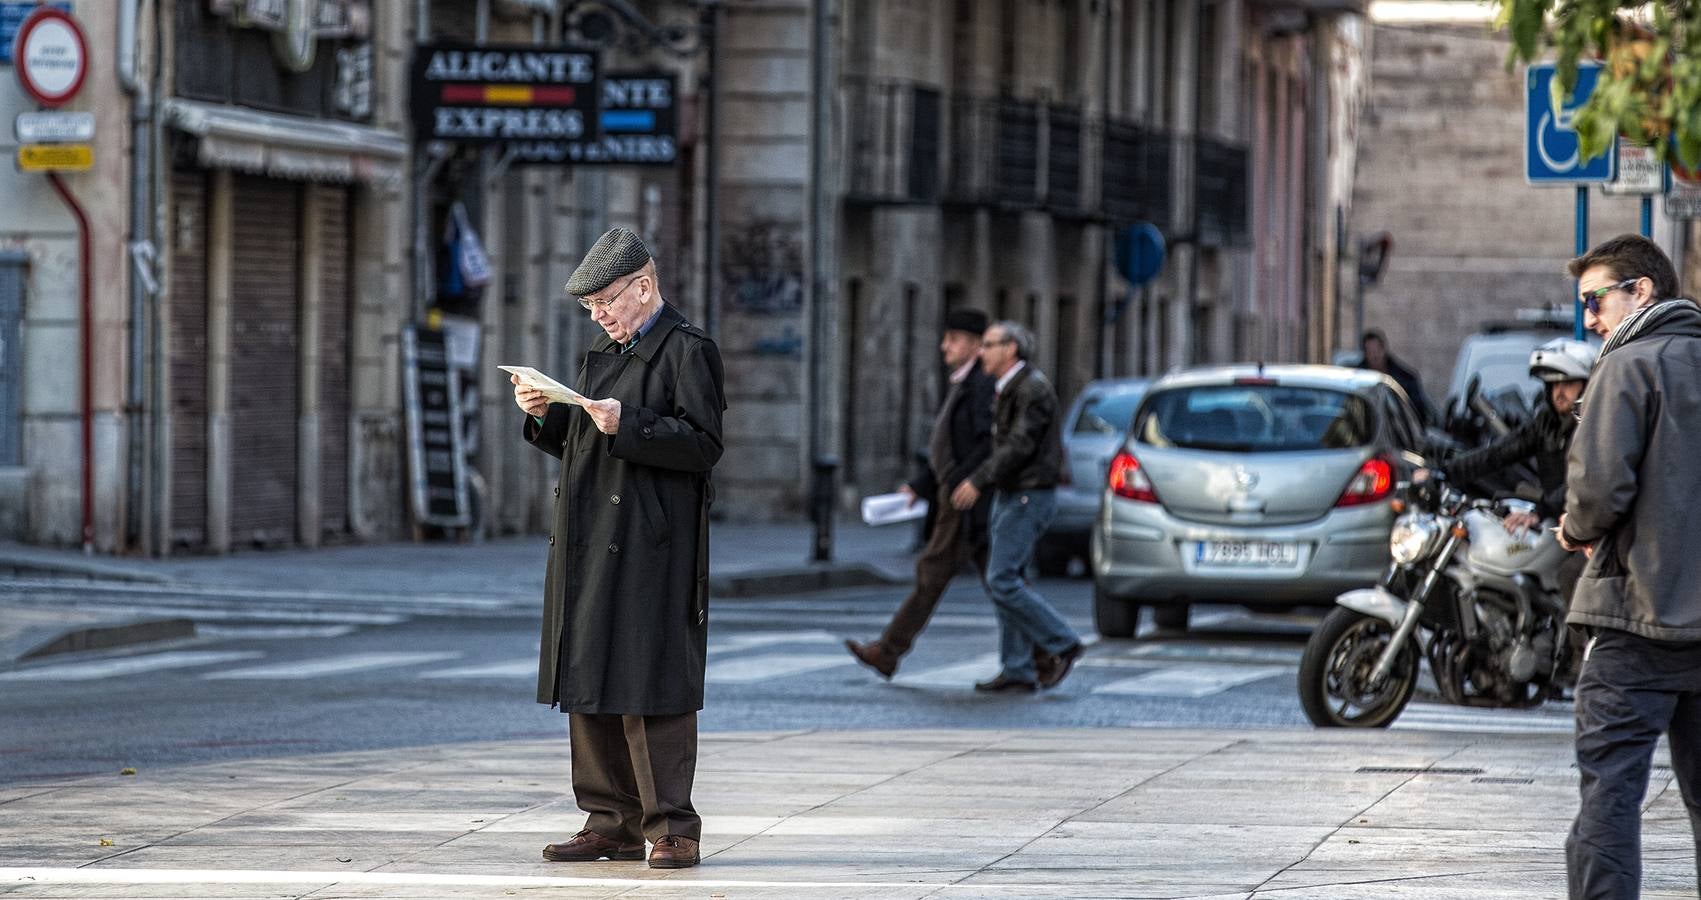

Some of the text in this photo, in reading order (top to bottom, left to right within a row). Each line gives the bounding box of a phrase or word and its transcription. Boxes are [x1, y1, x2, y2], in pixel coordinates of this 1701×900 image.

[425, 51, 594, 83] ALICANTE
[601, 79, 672, 108] NTE
[433, 106, 584, 138] EXPRESS
